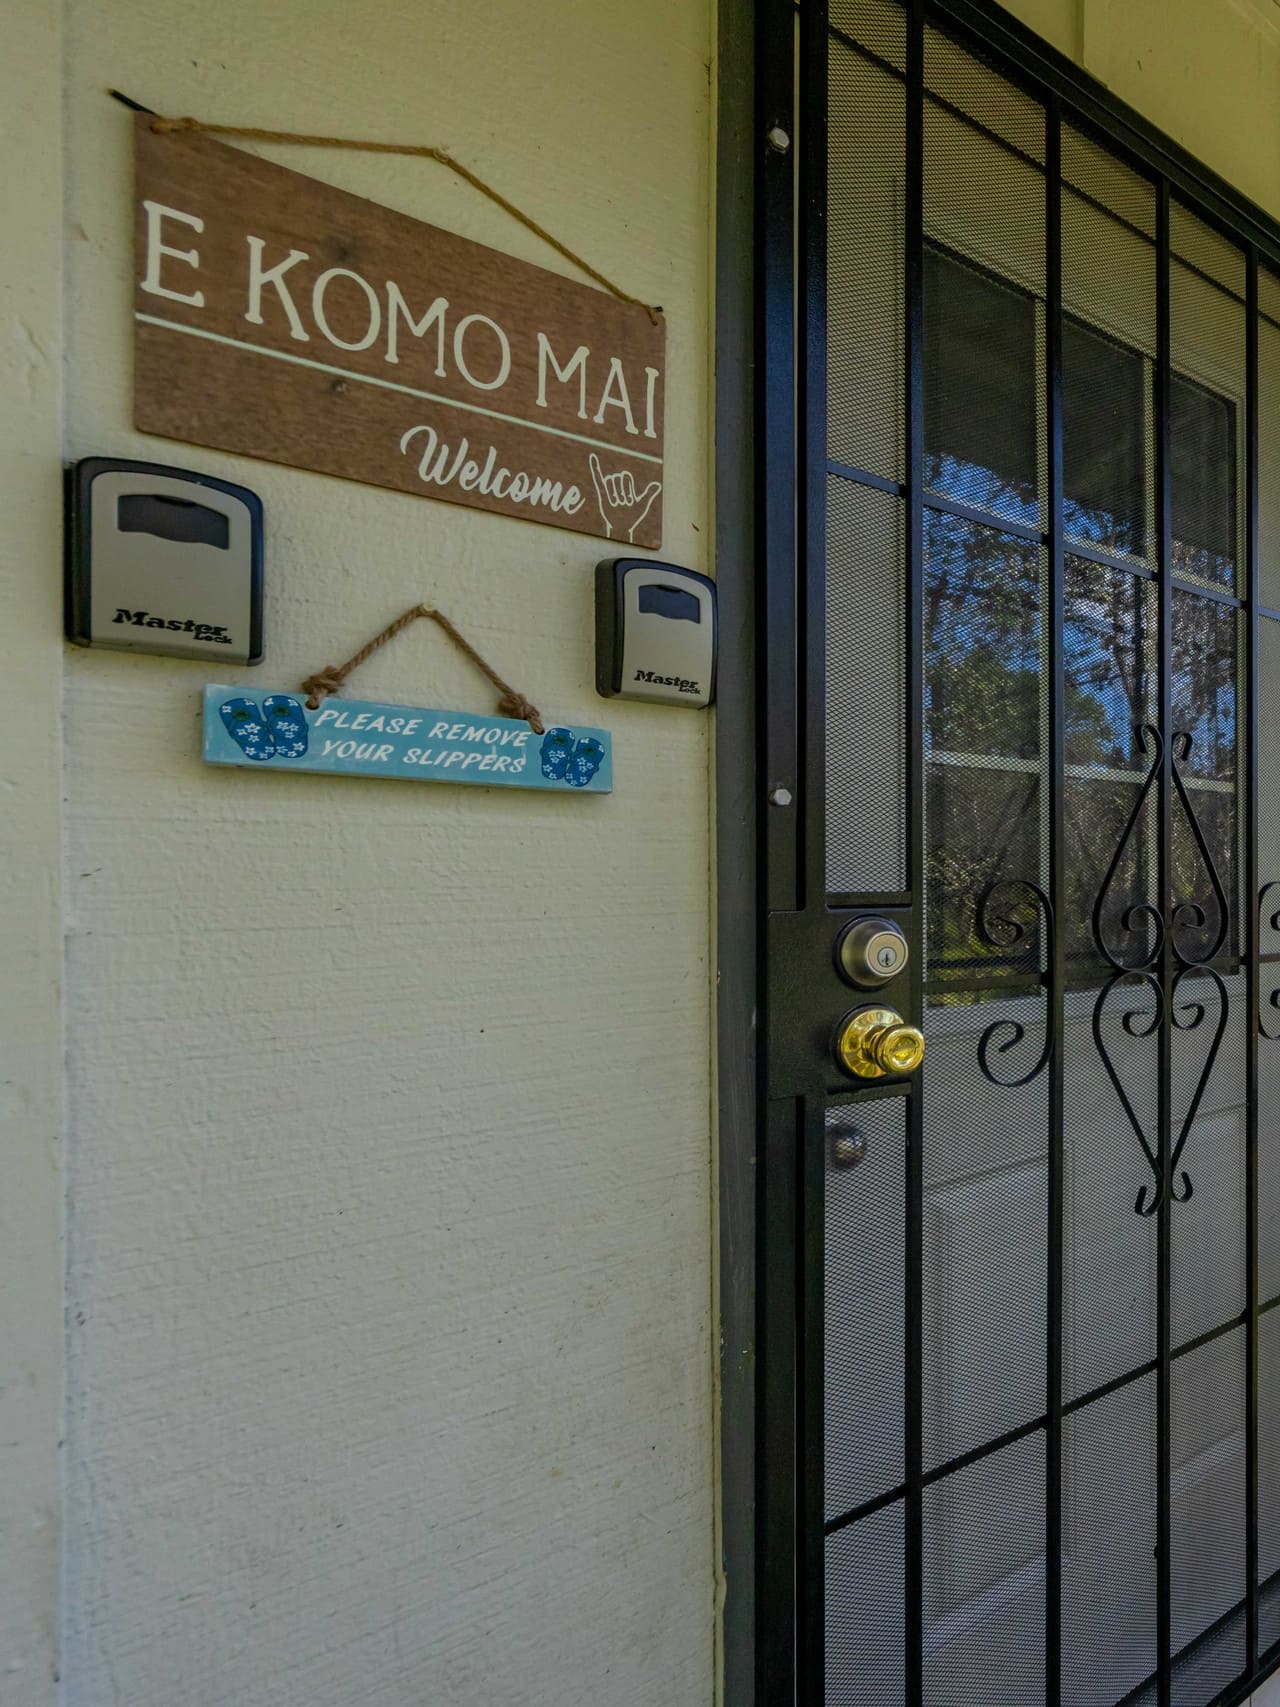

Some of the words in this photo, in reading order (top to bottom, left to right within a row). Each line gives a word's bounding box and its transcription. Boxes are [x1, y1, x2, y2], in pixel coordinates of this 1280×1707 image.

[141, 200, 205, 308] E
[245, 235, 510, 390] KOMO
[535, 333, 660, 439] MAI
[400, 425, 586, 516] Welcome
[112, 609, 228, 636] Master
[193, 631, 233, 644] Lock
[633, 670, 699, 688] Master
[678, 686, 701, 695] Lock
[314, 709, 423, 735] PLEASE
[428, 722, 531, 747] REMOVE
[320, 739, 395, 761] YOUR
[403, 748, 525, 773] SLIPPERS
